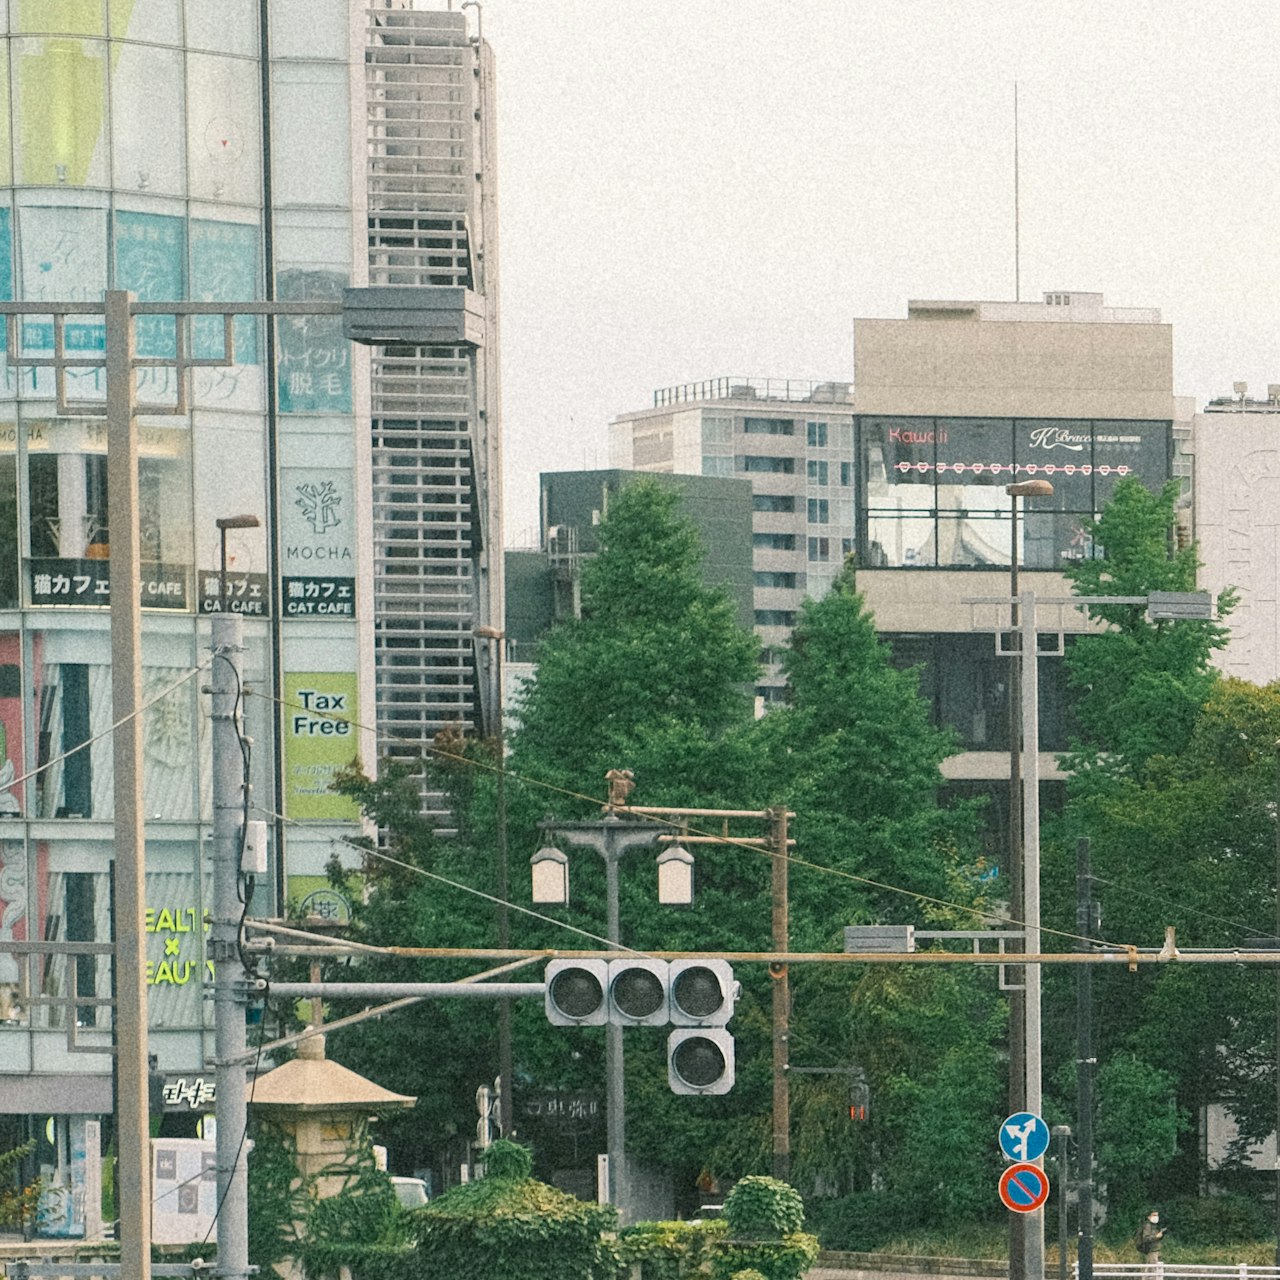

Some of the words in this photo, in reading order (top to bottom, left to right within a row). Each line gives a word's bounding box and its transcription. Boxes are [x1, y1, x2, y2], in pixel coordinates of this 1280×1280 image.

[287, 546, 351, 560] MOCHA
[35, 574, 110, 595] 猫カフェ
[148, 581, 182, 595] CAFE
[288, 581, 351, 598] 猫カフェ
[231, 601, 262, 613] CAFE
[287, 603, 314, 614] CAT
[318, 603, 351, 614] CAFE
[298, 692, 345, 710] Tax
[294, 717, 350, 735] Free
